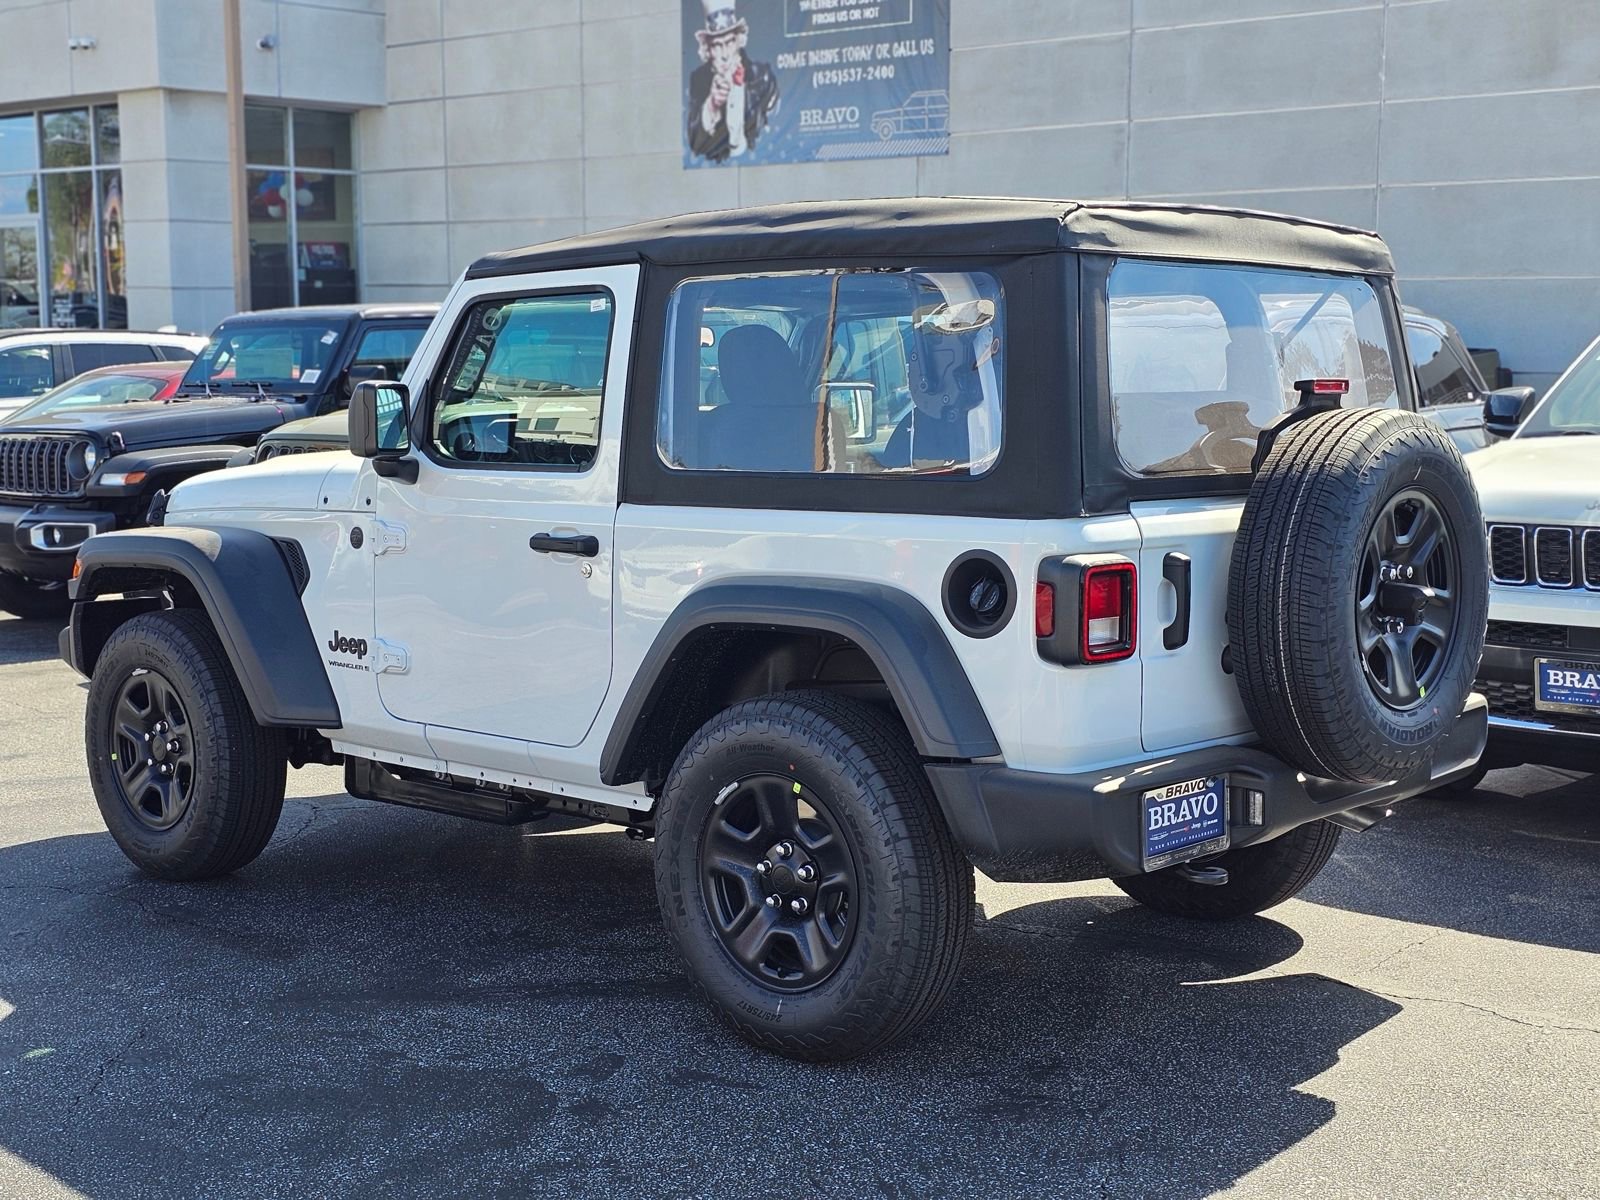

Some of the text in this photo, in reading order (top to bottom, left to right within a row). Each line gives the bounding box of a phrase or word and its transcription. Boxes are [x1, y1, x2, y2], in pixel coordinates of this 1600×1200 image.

[812, 7, 880, 25] FROM US OR NOT
[776, 38, 935, 69] COME INSIDE TODAY OR CALL US
[800, 106, 859, 125] BRAVO
[328, 630, 368, 660] Jeep
[328, 660, 363, 671] WRANGLER
[1547, 669, 1600, 690] BRA
[1379, 719, 1433, 742] ROADIAN
[727, 743, 776, 753] All-Weather
[1165, 778, 1206, 799] BRAVO
[1148, 792, 1218, 831] BRAVO
[669, 799, 690, 917] NEXEN
[737, 1000, 783, 1023] 245/75R17
